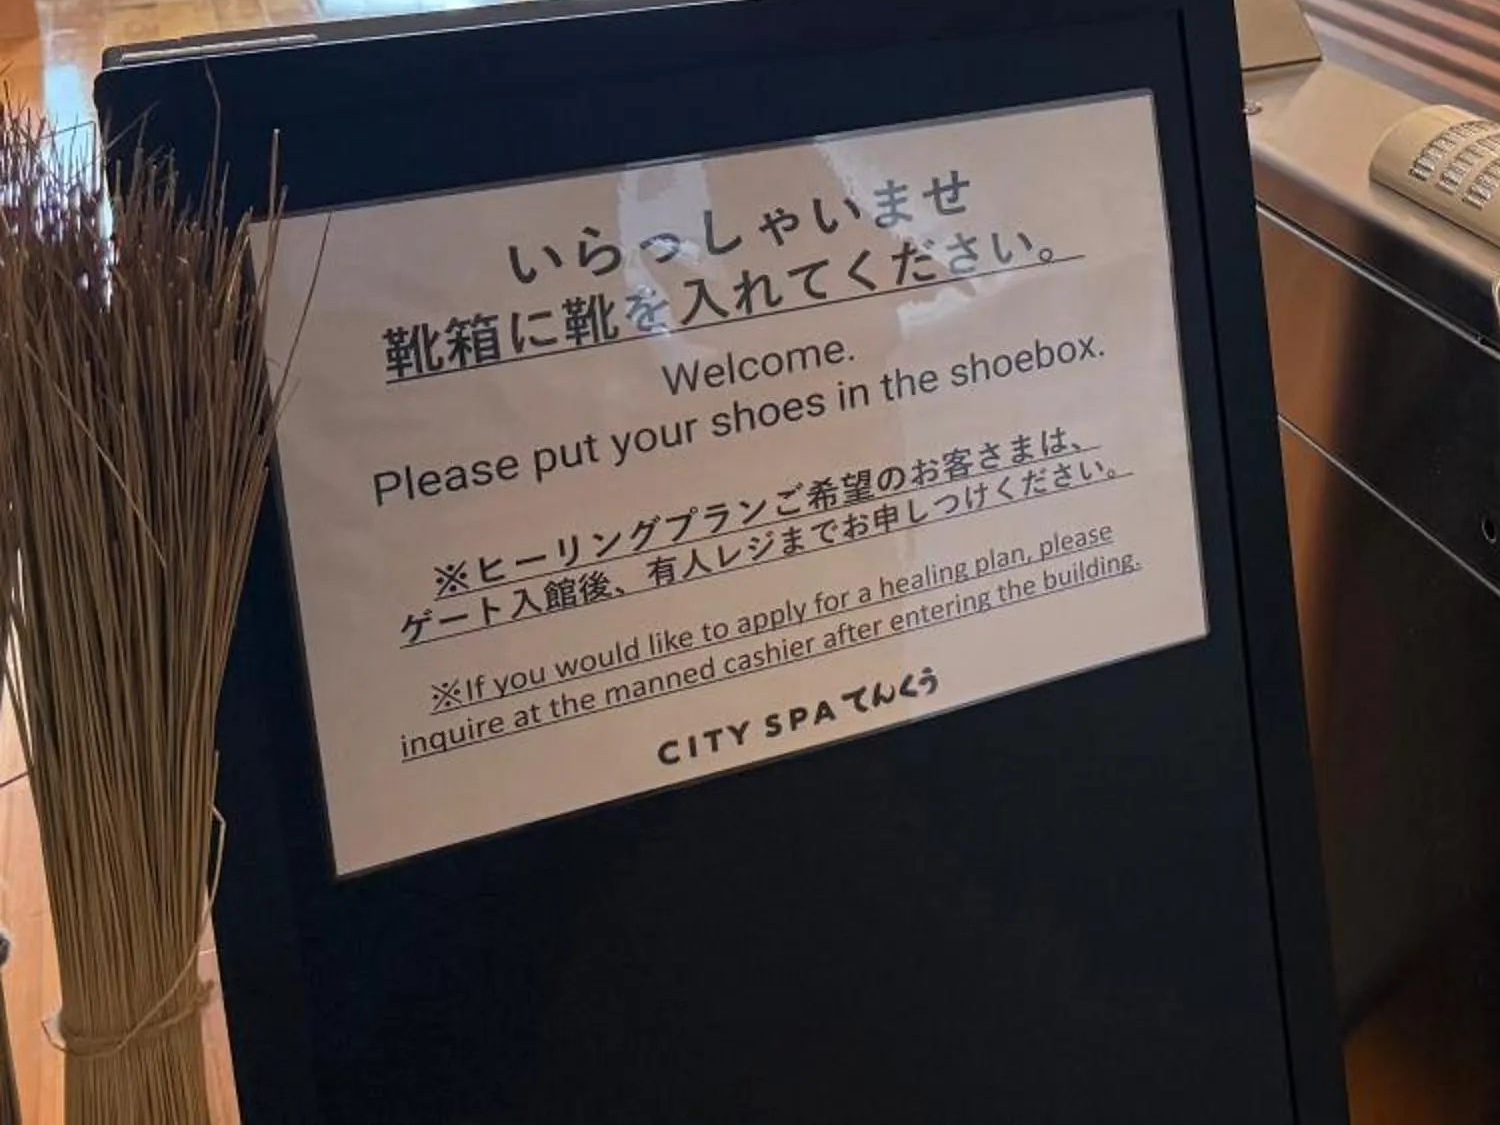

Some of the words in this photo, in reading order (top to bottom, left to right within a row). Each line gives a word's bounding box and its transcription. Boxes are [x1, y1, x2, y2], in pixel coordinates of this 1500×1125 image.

[508, 171, 970, 284] いらっしゃいませ
[382, 232, 1054, 378] 靴箱に靴を入れてください。
[662, 339, 854, 395] Welcome.
[373, 454, 519, 507] Please
[533, 434, 599, 482] put
[611, 417, 698, 467] your
[711, 393, 825, 437] shoes
[839, 381, 868, 411] in
[881, 368, 938, 401] the
[951, 335, 1104, 387] shoebox.
[401, 715, 505, 758] inquire
[514, 703, 541, 729] at
[550, 689, 596, 719] the
[606, 657, 715, 704] manned
[724, 636, 817, 674] cashier
[824, 619, 881, 649] after
[891, 588, 992, 630] entering
[998, 576, 1036, 605] the
[1043, 552, 1142, 592] building.
[493, 666, 545, 698] you
[555, 637, 640, 678] would
[649, 630, 693, 655] like
[703, 622, 729, 643] to
[738, 600, 806, 635] apply
[815, 590, 850, 614] for
[859, 586, 871, 603] a
[880, 558, 968, 599] healing
[976, 544, 1031, 581] plan,
[1039, 523, 1113, 562] please
[658, 720, 750, 765] CITY
[765, 700, 836, 738] SPA
[841, 666, 939, 713] てんくう
